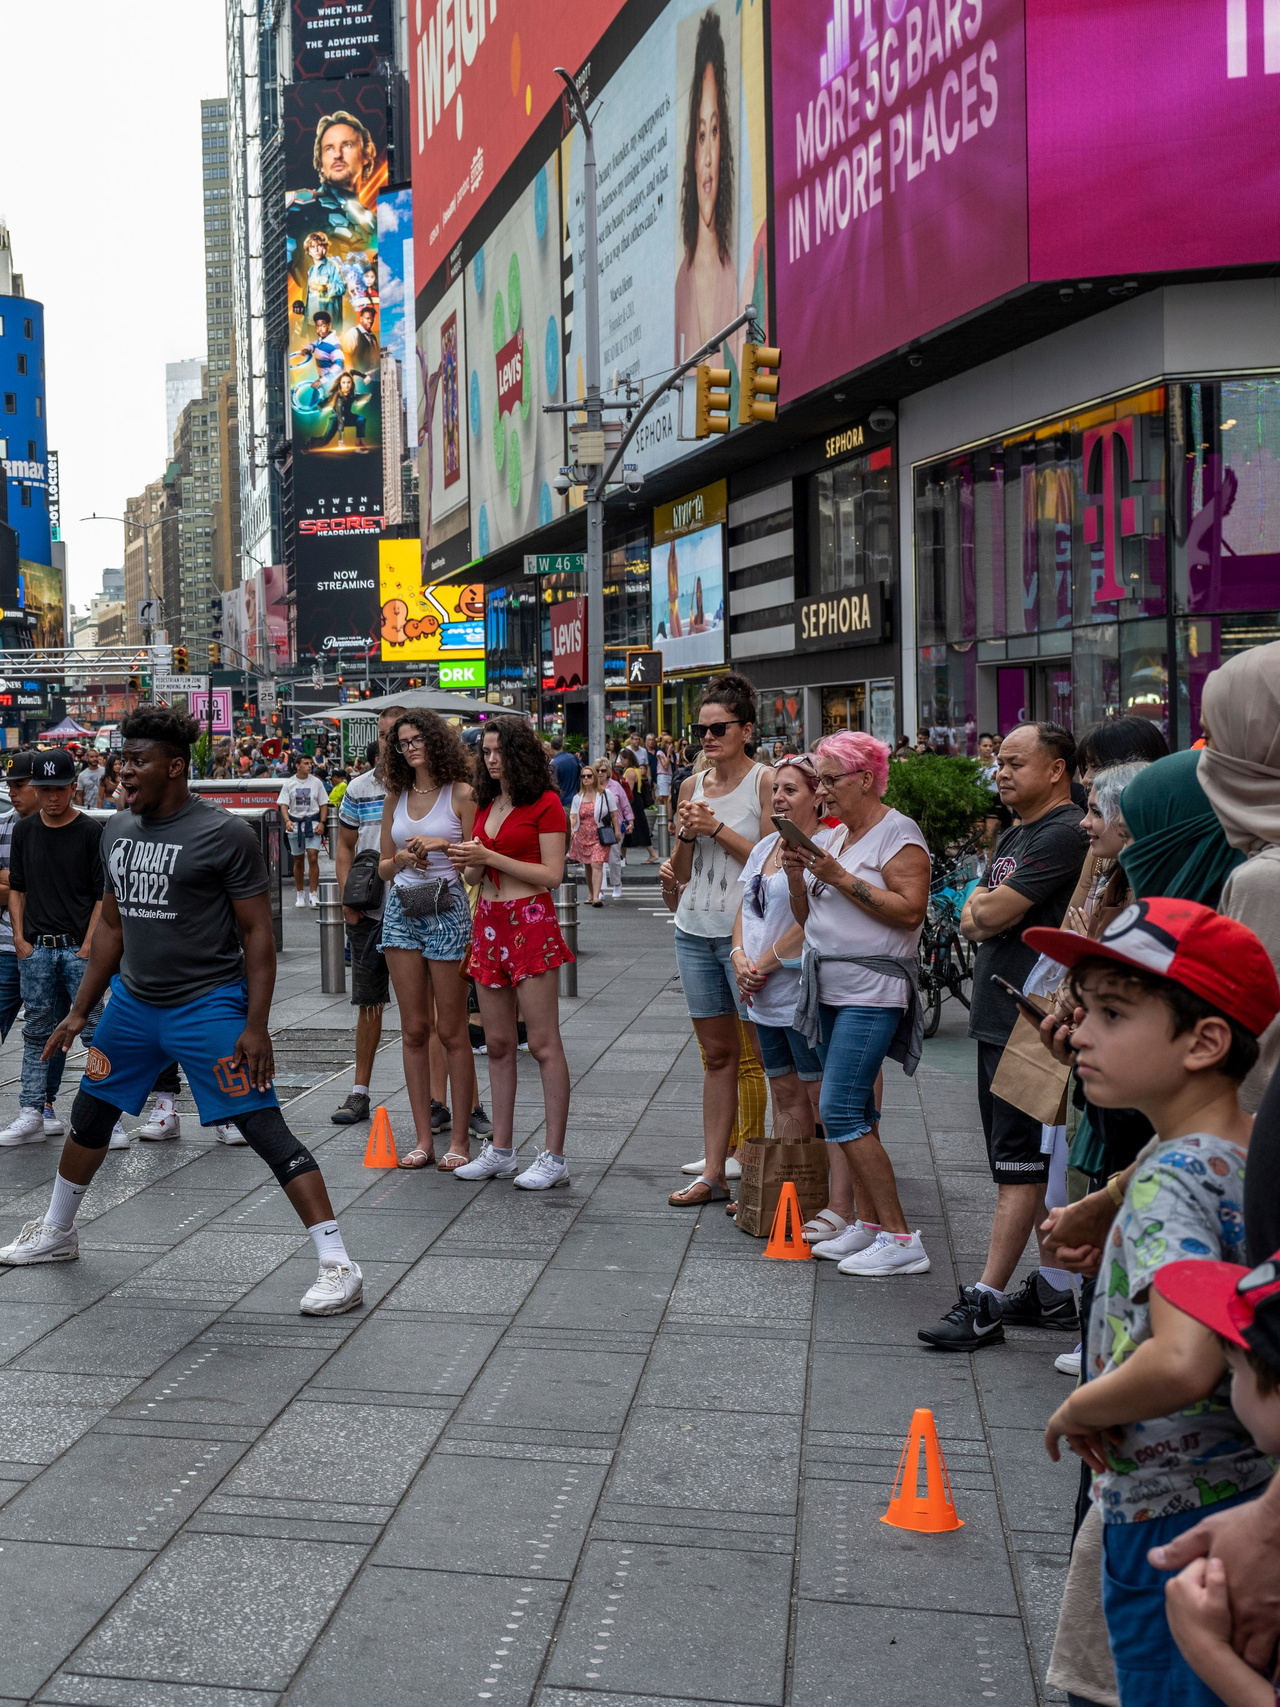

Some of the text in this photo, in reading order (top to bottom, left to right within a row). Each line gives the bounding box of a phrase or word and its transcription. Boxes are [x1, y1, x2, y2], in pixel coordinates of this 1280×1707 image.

[318, 4, 363, 16] WHEN THE
[307, 19, 340, 28] SECRET
[354, 16, 372, 24] OUT
[306, 34, 379, 49] THE ADVENTURE
[324, 49, 360, 58] BEGINS.
[796, 60, 860, 179] MORE
[866, 27, 899, 121] 5G
[789, 39, 998, 263] IN MORE PLACES
[635, 412, 674, 454] SEPHORA
[825, 426, 864, 459] SEPHORA
[318, 496, 368, 506] OWEN
[306, 504, 380, 515] WILSON
[299, 516, 386, 534] SECRET
[318, 528, 380, 537] HEADQUARTERS
[538, 556, 584, 572] W 46 St
[334, 570, 358, 580] NOW
[318, 580, 374, 590] STREAMING
[801, 594, 872, 640] SEPHORA
[202, 700, 218, 709] TQ
[349, 724, 378, 746] BROAD
[130, 841, 183, 874] DRAFT
[129, 872, 169, 905] 2022
[995, 1162, 1020, 1171] PUMA
[1135, 1432, 1201, 1463] COOL IT
